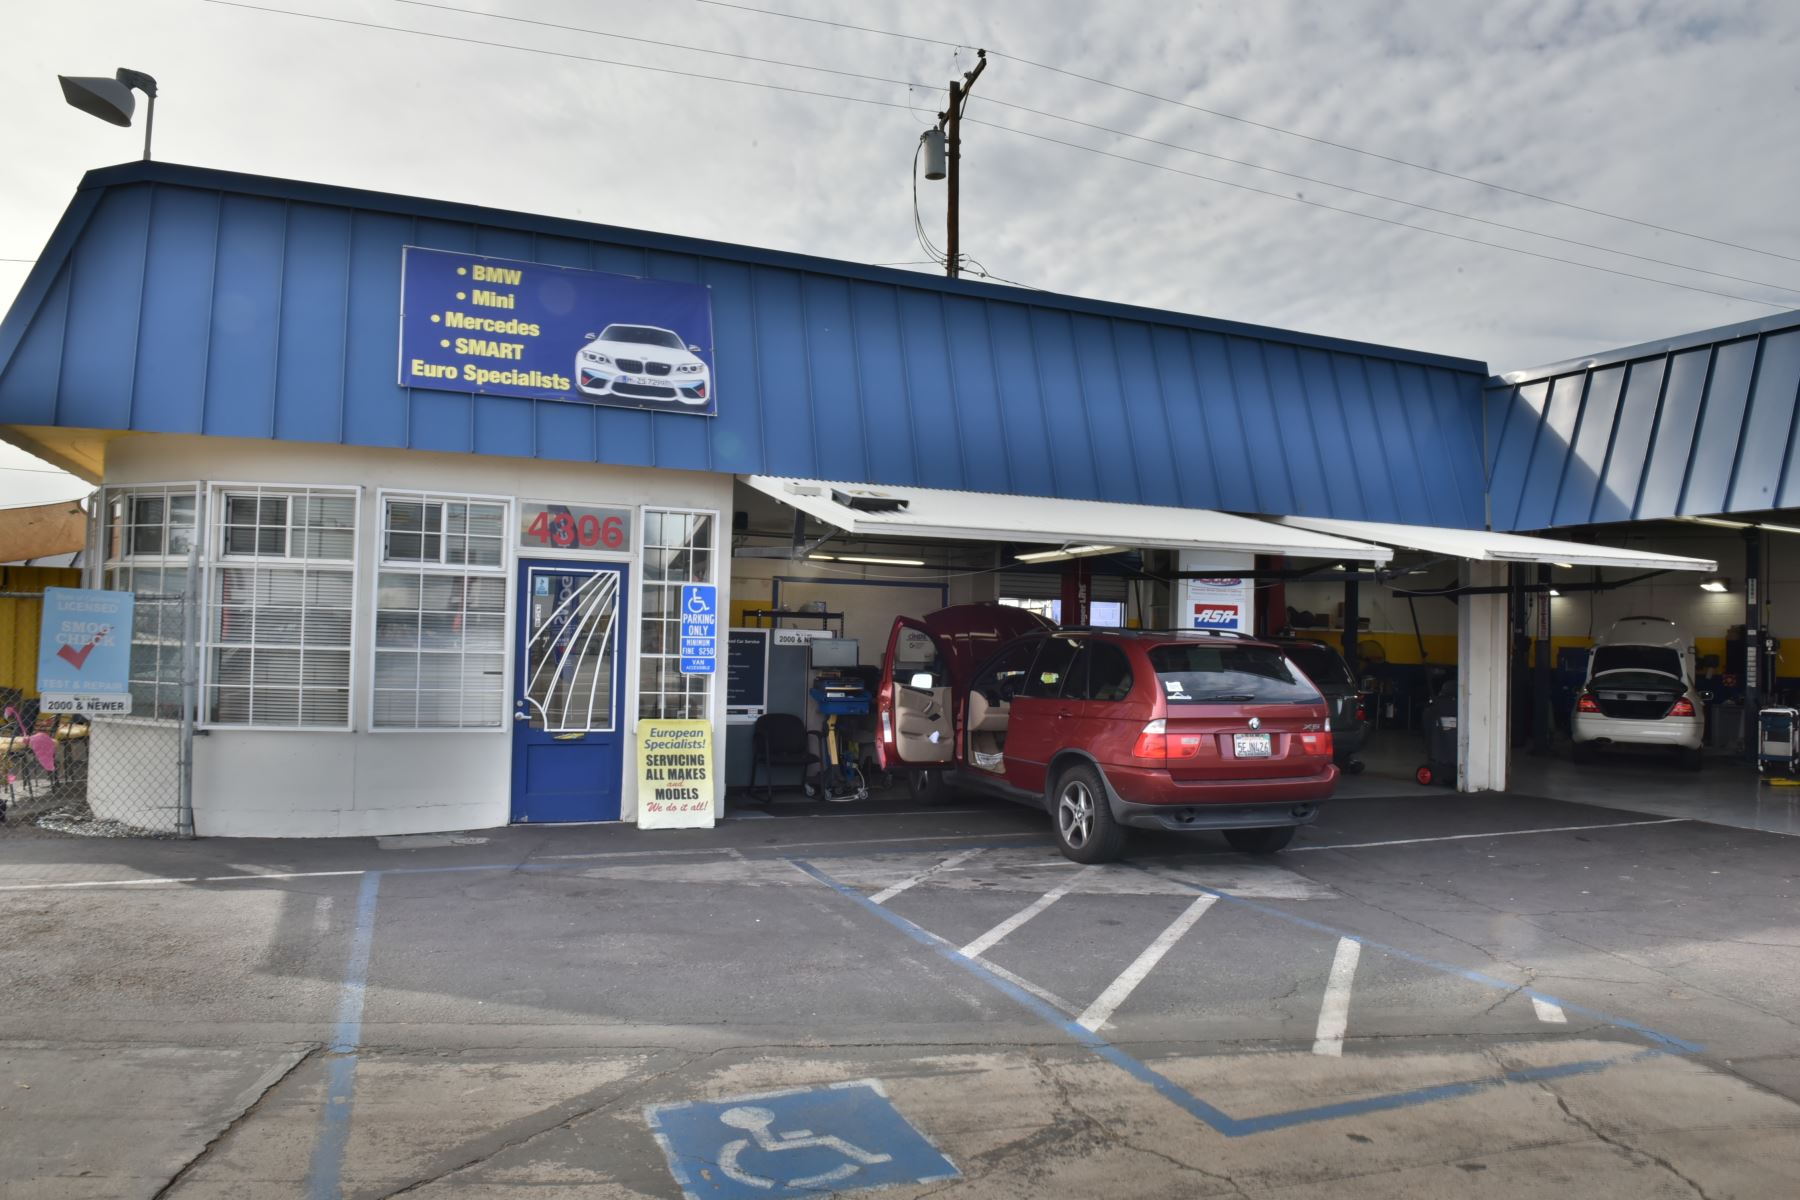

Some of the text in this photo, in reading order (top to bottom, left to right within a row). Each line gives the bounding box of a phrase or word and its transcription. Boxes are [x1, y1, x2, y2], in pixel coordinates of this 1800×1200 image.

[472, 265, 522, 285] BMW
[472, 289, 515, 309] Mini
[445, 311, 540, 337] Mercedes
[455, 338, 524, 360] SMART
[411, 359, 571, 391] Euro Specialists
[528, 511, 624, 548] 4306
[57, 602, 118, 613] LICENSED
[682, 614, 715, 625] PARKING
[61, 620, 111, 634] SMOG
[688, 625, 709, 636] ONLY
[55, 632, 115, 647] CHECK
[686, 639, 711, 647] MINIMUM
[779, 635, 796, 643] 2000
[43, 679, 70, 689] TEST
[48, 701, 125, 711] 2000 & NEWER
[649, 728, 704, 740] European
[644, 739, 706, 751] Specialists!
[646, 754, 705, 767] SERVICING
[646, 767, 706, 781] ALL MAKES
[666, 779, 684, 787] and
[655, 788, 699, 801] MODELS
[646, 801, 662, 812] We
[666, 802, 677, 812] do
[680, 802, 688, 812] it
